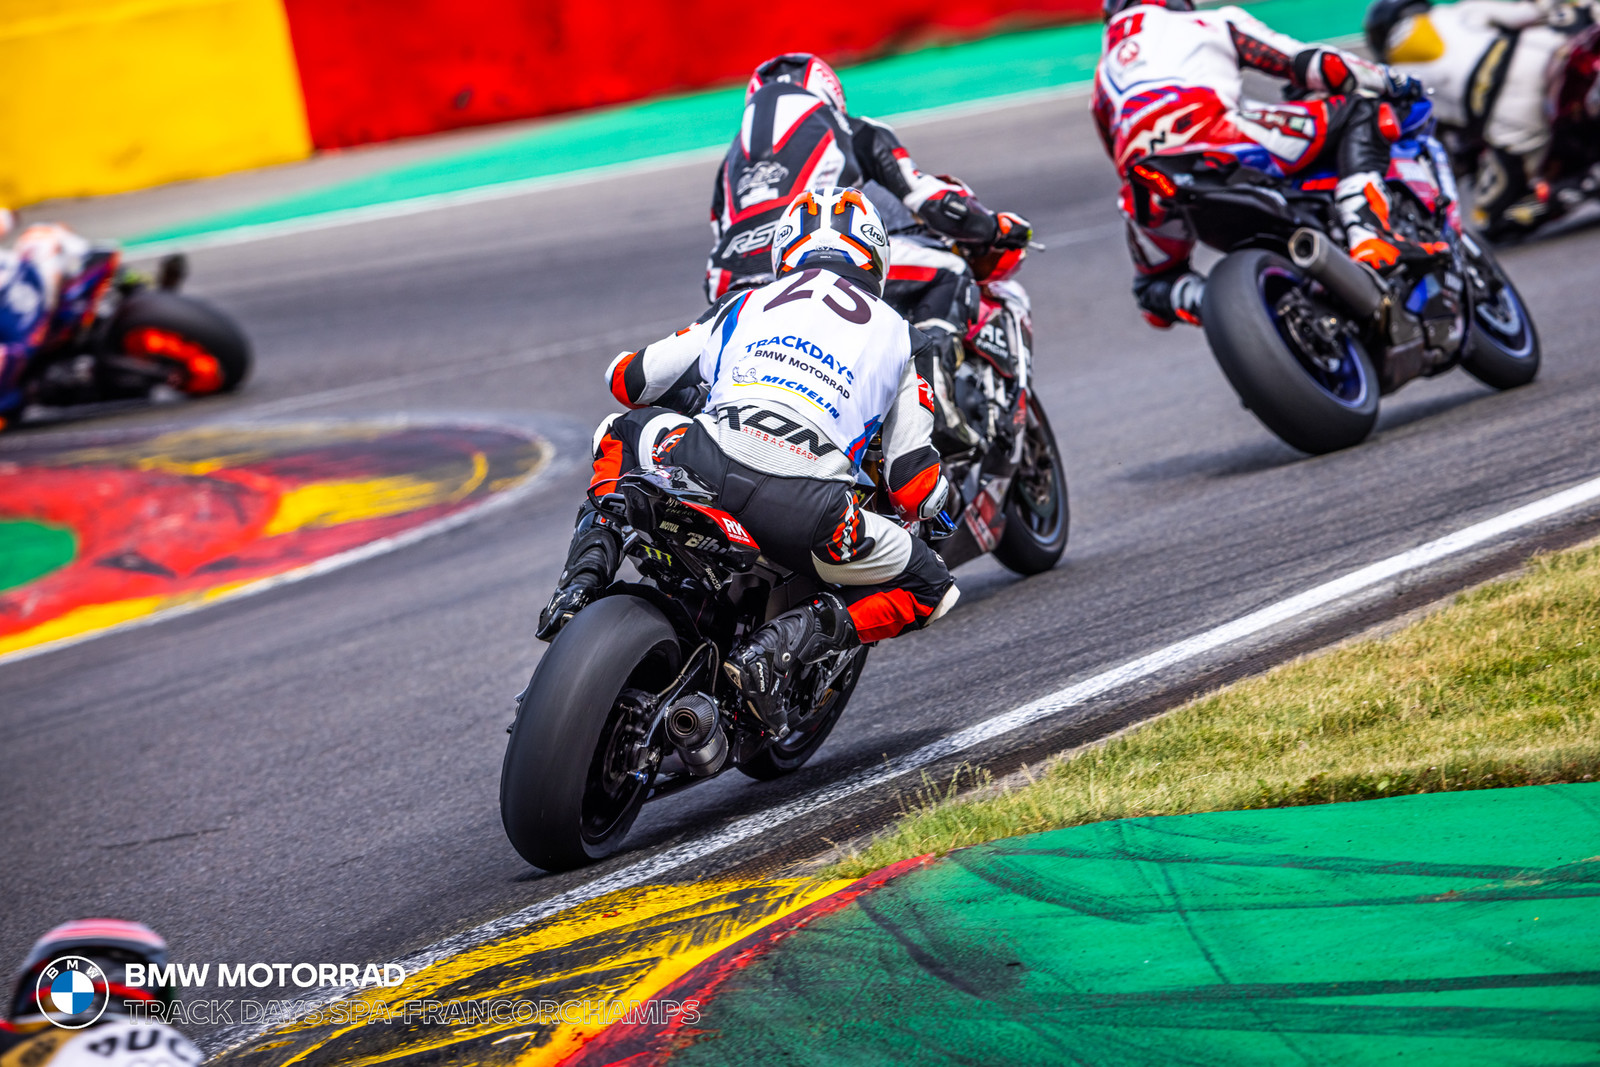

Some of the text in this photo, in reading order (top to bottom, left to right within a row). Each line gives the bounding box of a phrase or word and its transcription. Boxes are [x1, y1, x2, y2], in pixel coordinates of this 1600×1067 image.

[763, 268, 878, 325] 25
[745, 335, 855, 385] TRACKDAYS
[754, 349, 850, 399] BMW MOTORRAD
[761, 375, 840, 419] MICHELIN
[741, 426, 819, 462] AIRBAG READY
[659, 520, 680, 534] MOTUL
